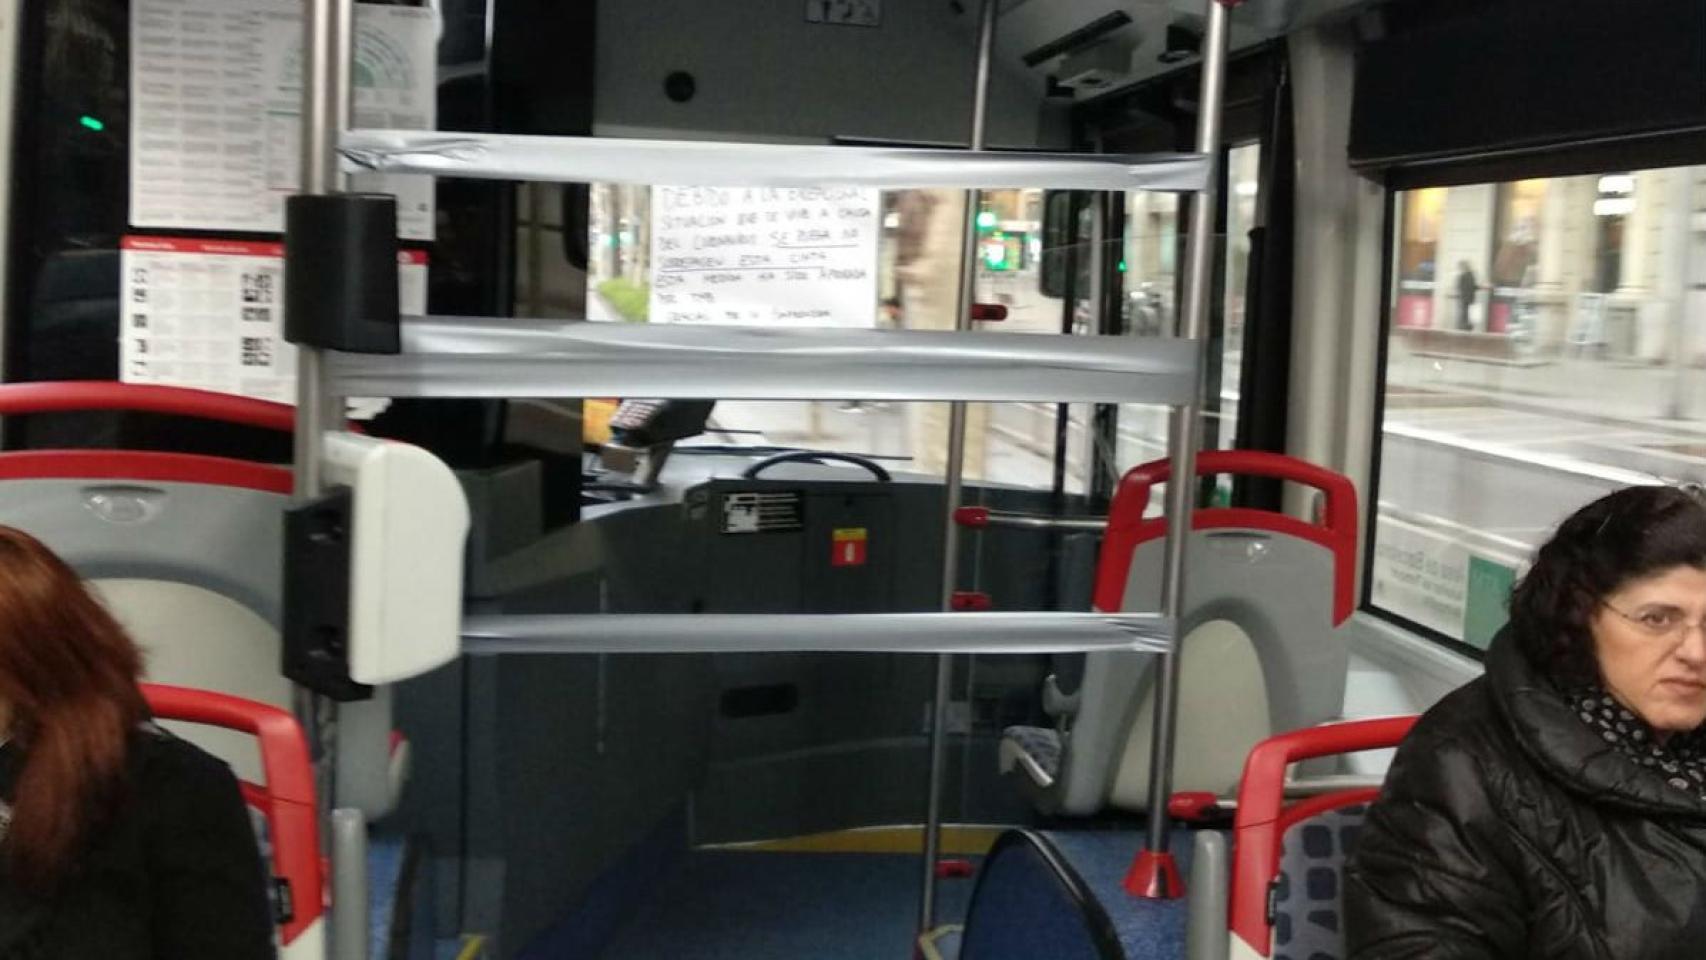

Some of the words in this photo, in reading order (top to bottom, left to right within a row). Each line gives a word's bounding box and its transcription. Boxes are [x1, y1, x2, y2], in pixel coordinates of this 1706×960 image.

[743, 189, 753, 202] A
[761, 188, 779, 202] LA
[819, 208, 829, 217] A
